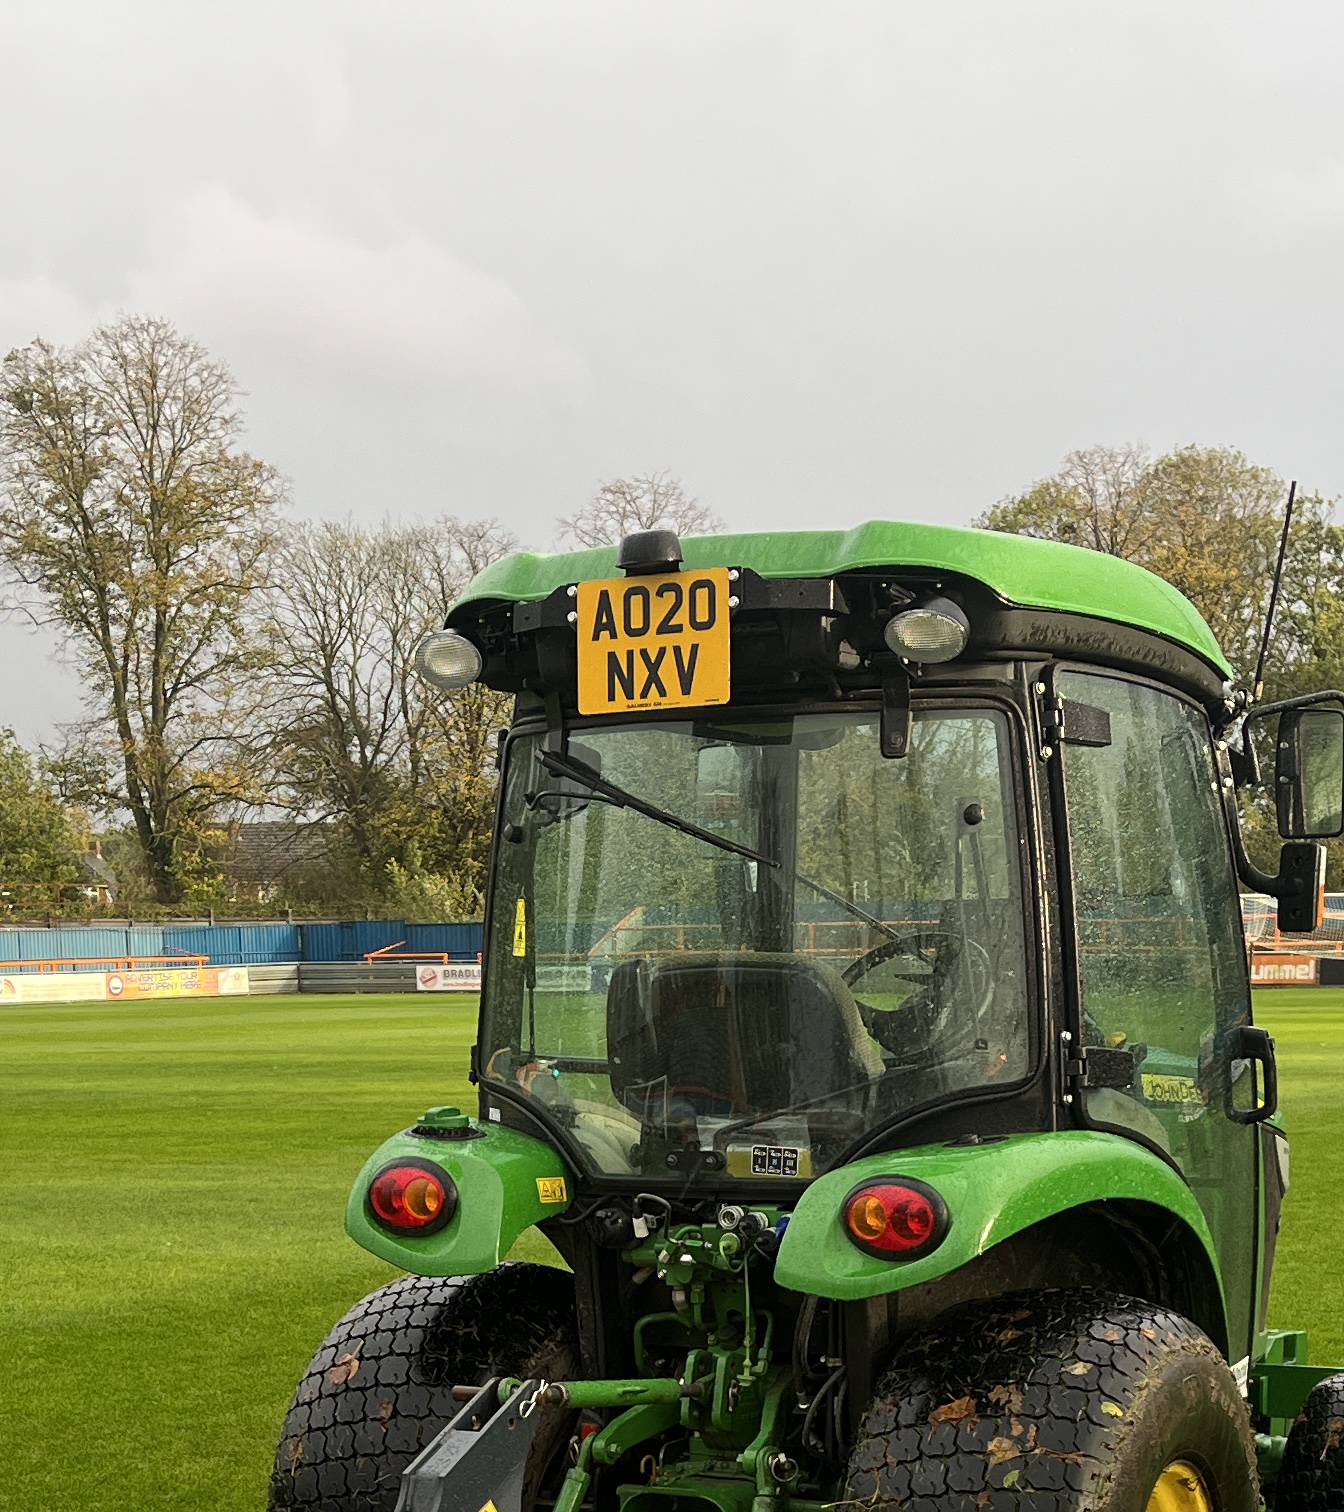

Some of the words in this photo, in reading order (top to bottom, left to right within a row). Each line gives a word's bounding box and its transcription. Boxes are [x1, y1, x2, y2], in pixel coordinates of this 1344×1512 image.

[591, 579, 716, 641] AO20
[607, 643, 699, 702] NXV
[126, 973, 173, 982] ADVERTISE
[177, 972, 197, 980] YOUR
[1251, 959, 1315, 979] ummel
[139, 982, 178, 991] COMPANY
[181, 981, 202, 989] HERE
